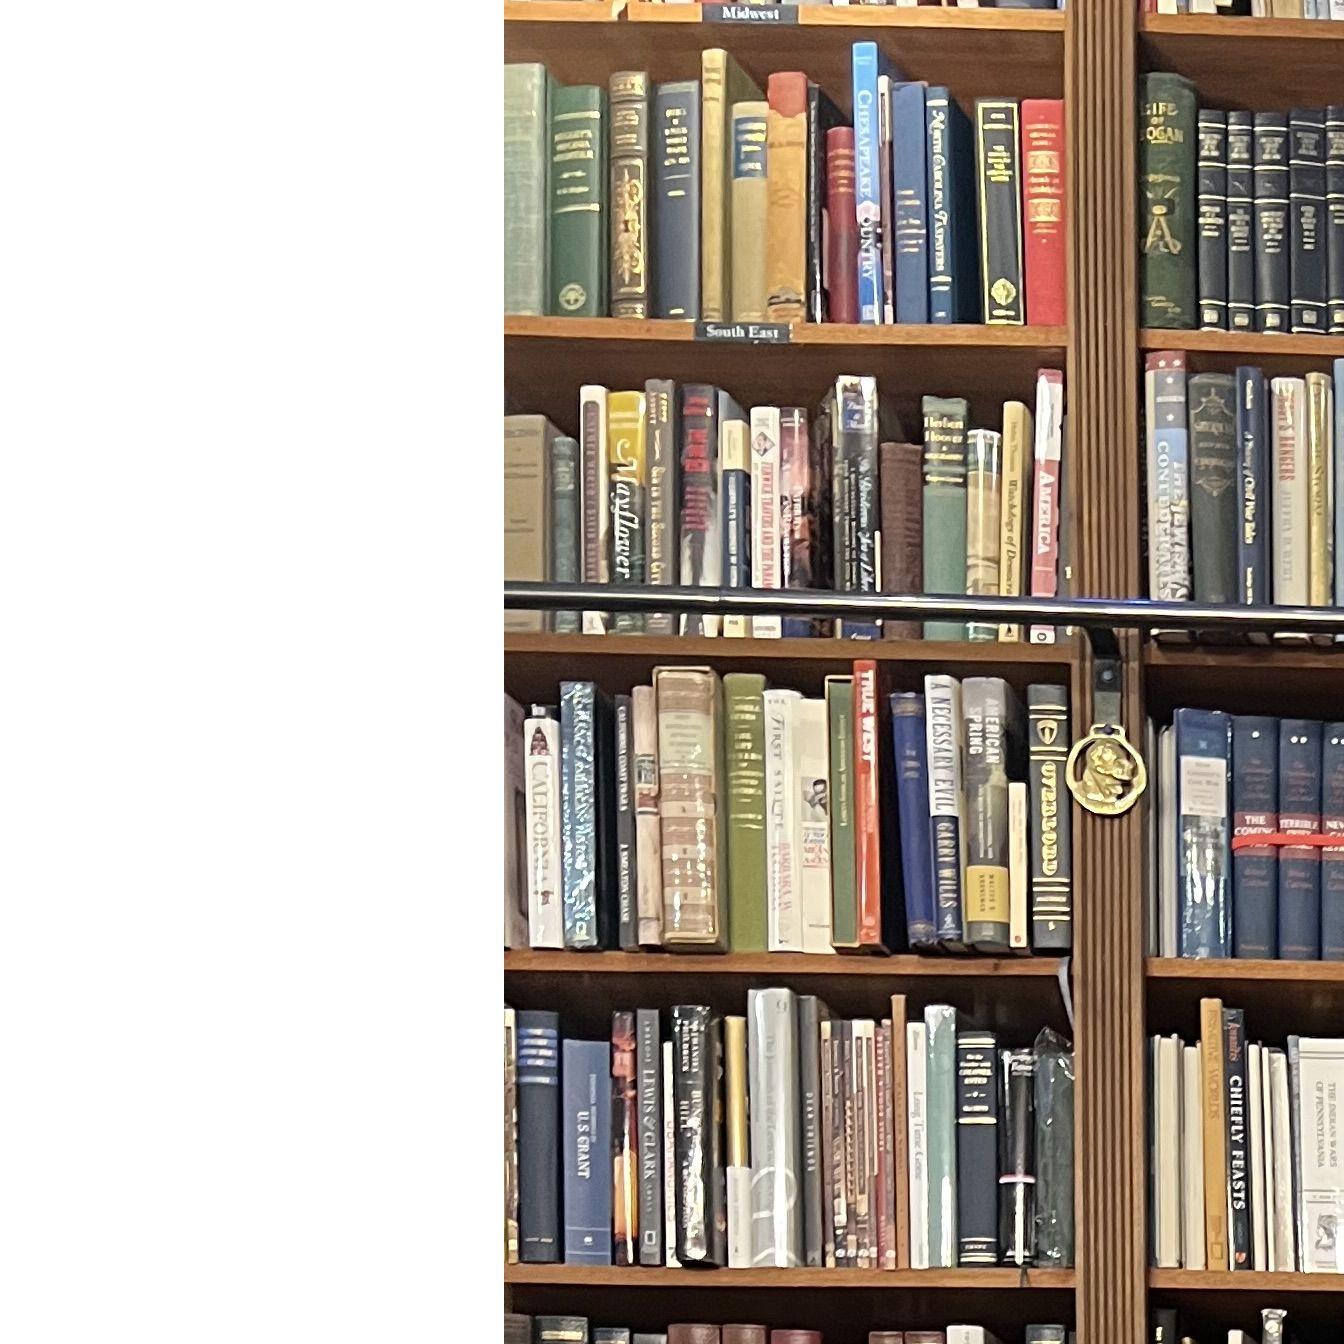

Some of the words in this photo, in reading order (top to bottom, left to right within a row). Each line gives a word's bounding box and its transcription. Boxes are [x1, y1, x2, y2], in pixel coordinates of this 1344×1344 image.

[722, 6, 780, 21] Midwest
[857, 89, 874, 197] CHESAPEAKE
[859, 200, 875, 281] COUNTRY
[706, 324, 745, 338] South
[748, 325, 778, 339] East
[1279, 435, 1295, 480] RANGERS
[609, 438, 639, 579] Mayflower
[1037, 470, 1055, 554] AMERICA
[861, 669, 874, 712] TRUE
[931, 682, 949, 691] A
[862, 715, 876, 763] WEST
[931, 698, 954, 773] NECESSARY
[969, 706, 983, 755] SPRING
[985, 698, 1000, 764] AMERICAN
[935, 778, 958, 811] EVIL
[1041, 760, 1057, 877] OVERLORD
[937, 822, 955, 863] GARRY
[1245, 815, 1266, 824] THE
[939, 867, 957, 908] WILLS
[1229, 1075, 1244, 1144] CHIEFLY
[1231, 1150, 1245, 1210] FEASTS
